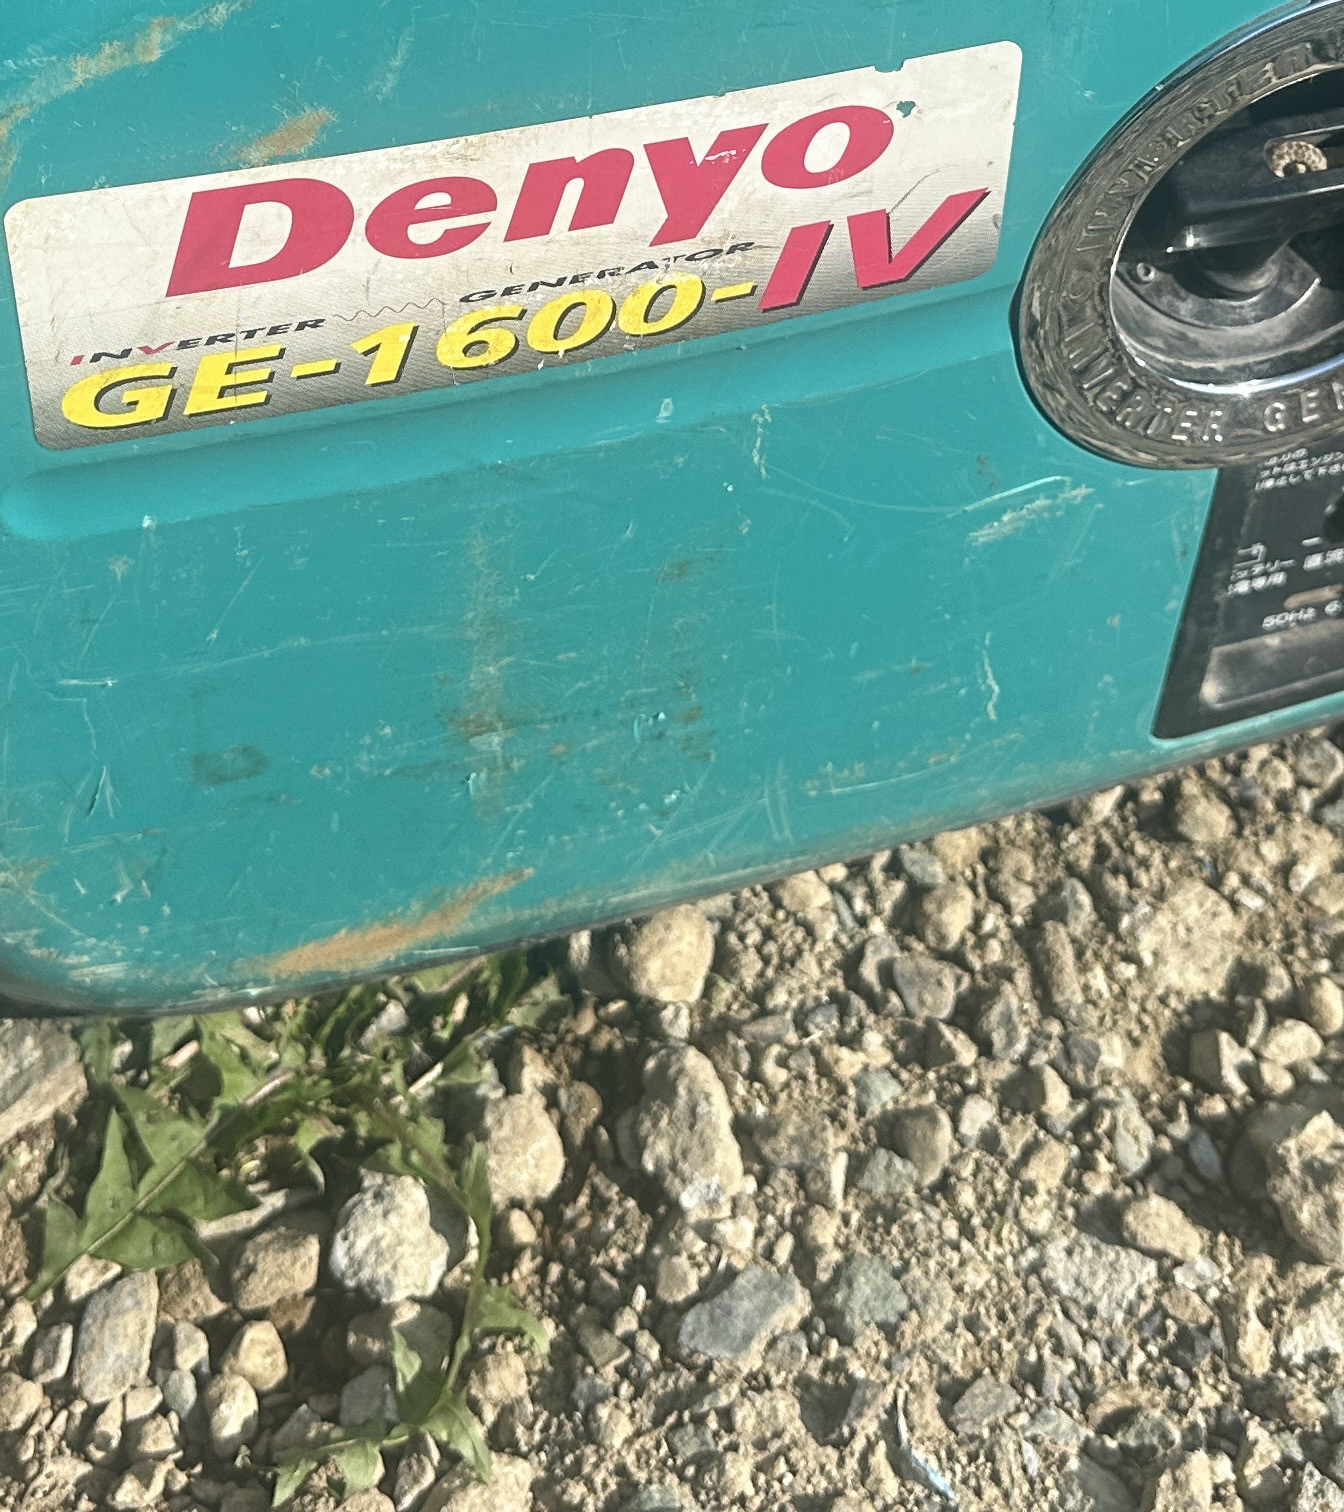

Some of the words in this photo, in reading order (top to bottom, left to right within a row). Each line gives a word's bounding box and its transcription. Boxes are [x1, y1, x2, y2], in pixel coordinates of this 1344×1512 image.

[164, 104, 895, 299] Denyo
[60, 188, 991, 432] GE-1600-IV
[70, 317, 326, 368] INVERTER
[458, 240, 756, 305] GENERATOR
